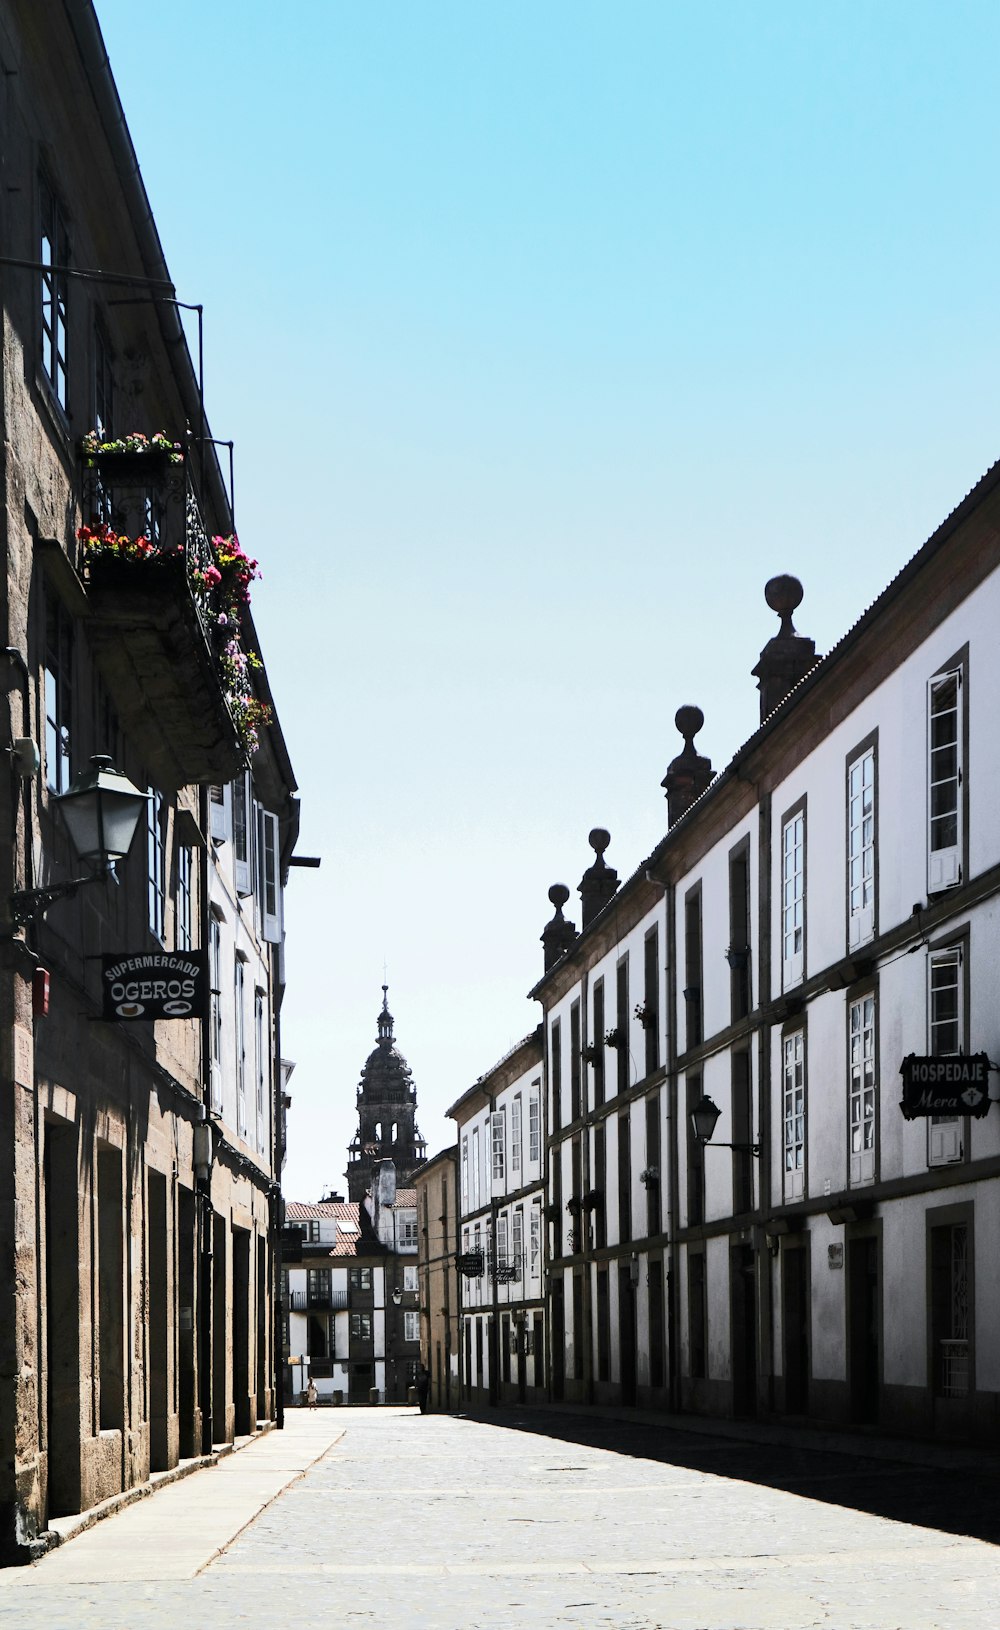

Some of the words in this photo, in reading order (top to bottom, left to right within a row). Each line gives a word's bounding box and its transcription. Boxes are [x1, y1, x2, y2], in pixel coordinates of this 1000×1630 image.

[105, 955, 200, 981] SUPERMERCADO
[111, 980, 195, 1001] OGEROS
[911, 1063, 984, 1082] HOSPEDAJE
[912, 1089, 957, 1109] Mera
